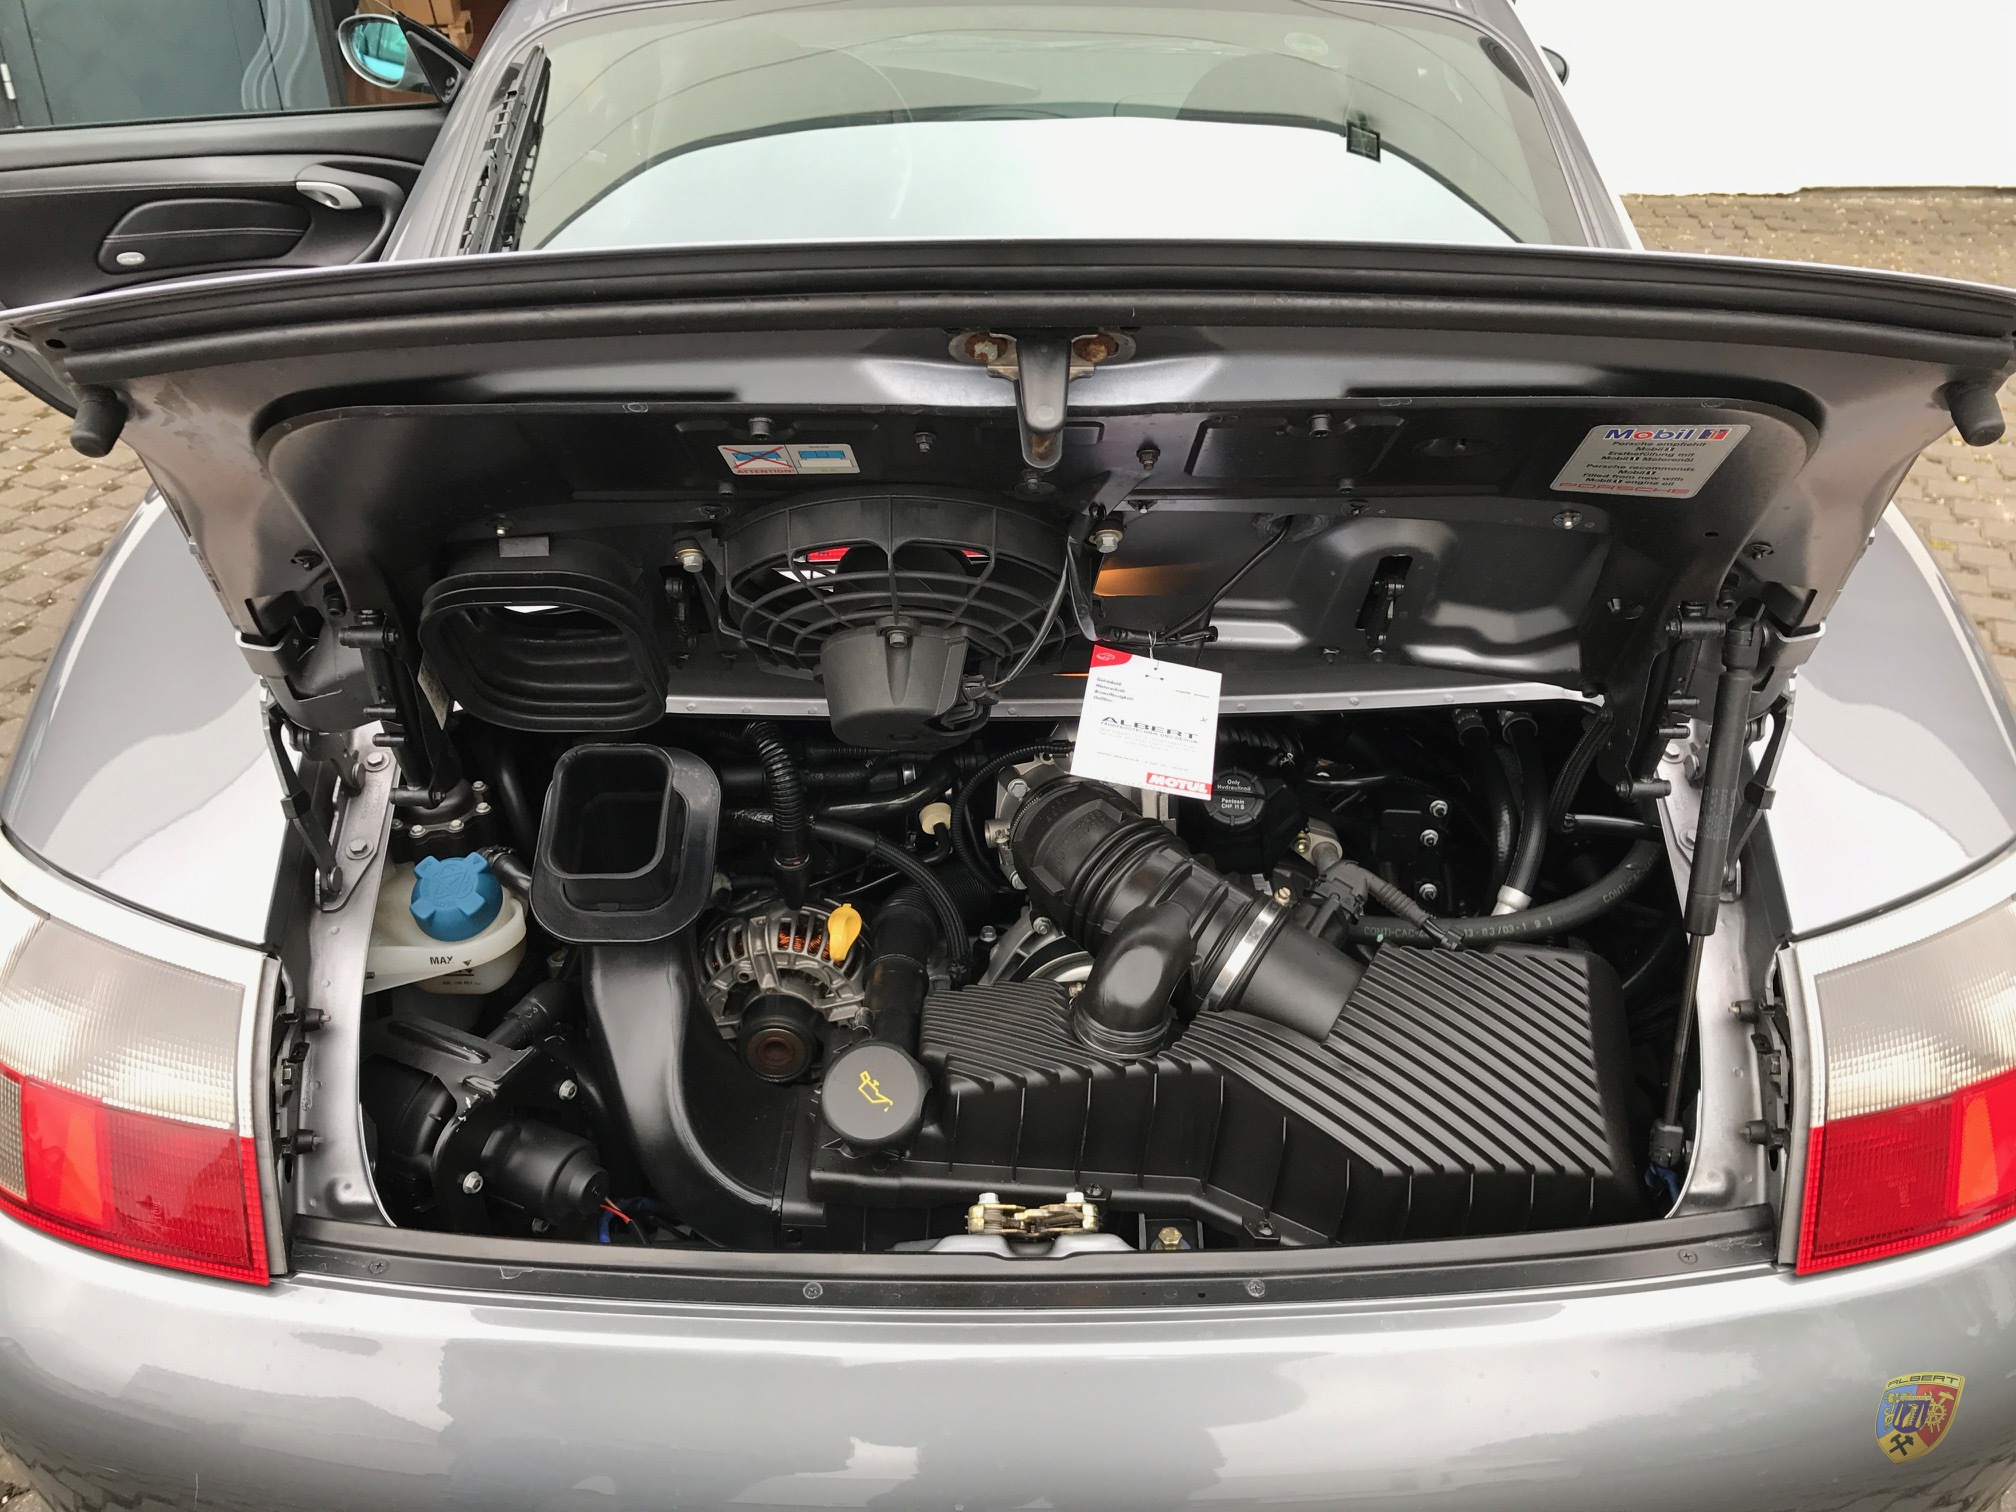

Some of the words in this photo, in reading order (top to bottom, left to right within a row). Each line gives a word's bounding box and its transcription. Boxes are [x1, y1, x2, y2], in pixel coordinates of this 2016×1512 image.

[1604, 429, 1696, 440] Mobil
[1559, 482, 1690, 495] PORSCHE
[1101, 717, 1199, 739] ALBERT
[1148, 774, 1208, 793] MOTUL
[1221, 797, 1245, 805] Pentosin
[1887, 1374, 1959, 1388] ALBERT
